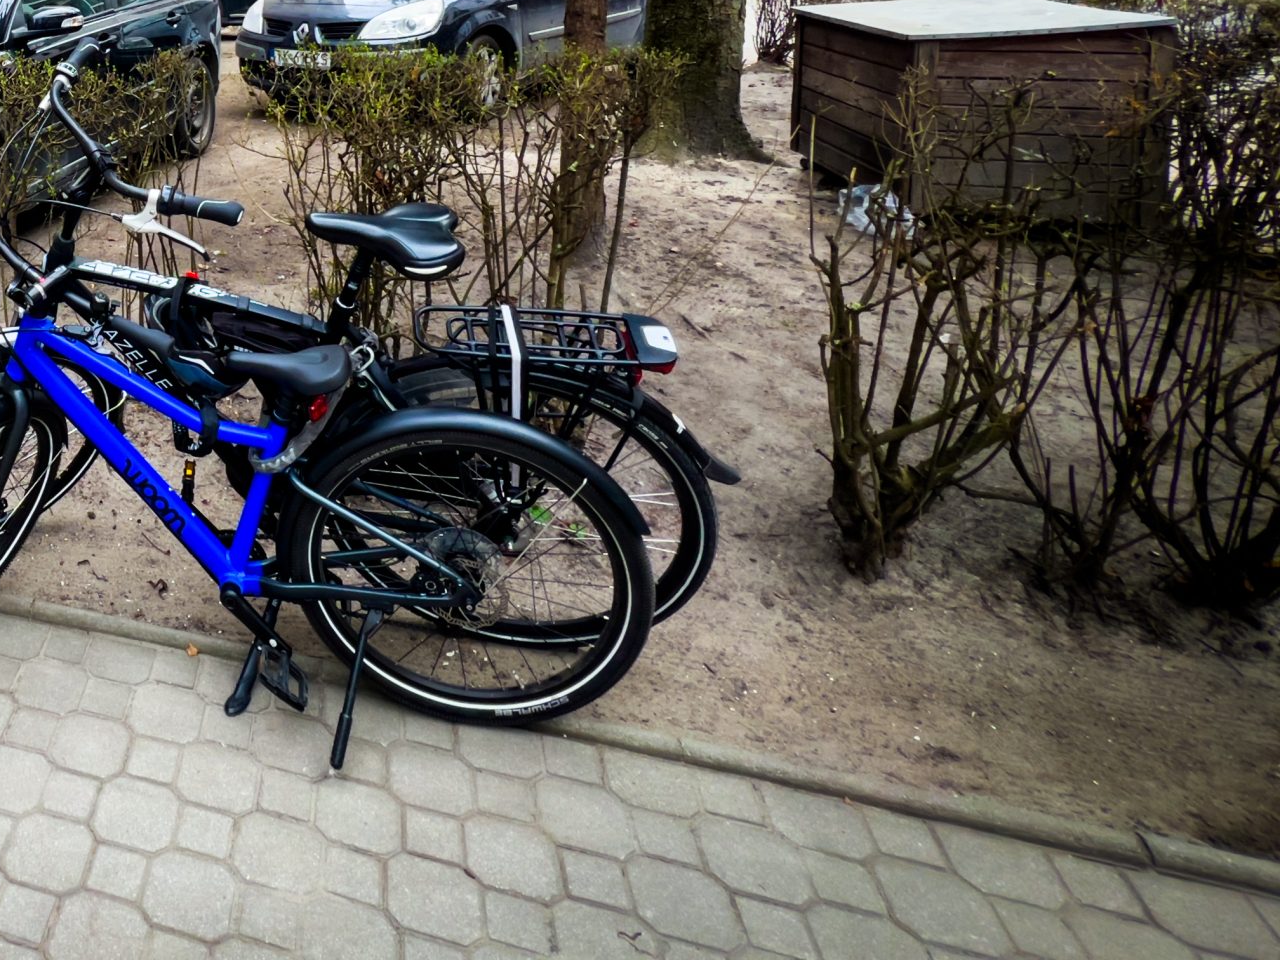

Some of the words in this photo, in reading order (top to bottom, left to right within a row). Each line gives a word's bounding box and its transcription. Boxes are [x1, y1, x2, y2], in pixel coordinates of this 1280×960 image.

[92, 319, 174, 391] AZELLE
[122, 457, 187, 536] woom
[494, 695, 570, 717] SCHWALBE
